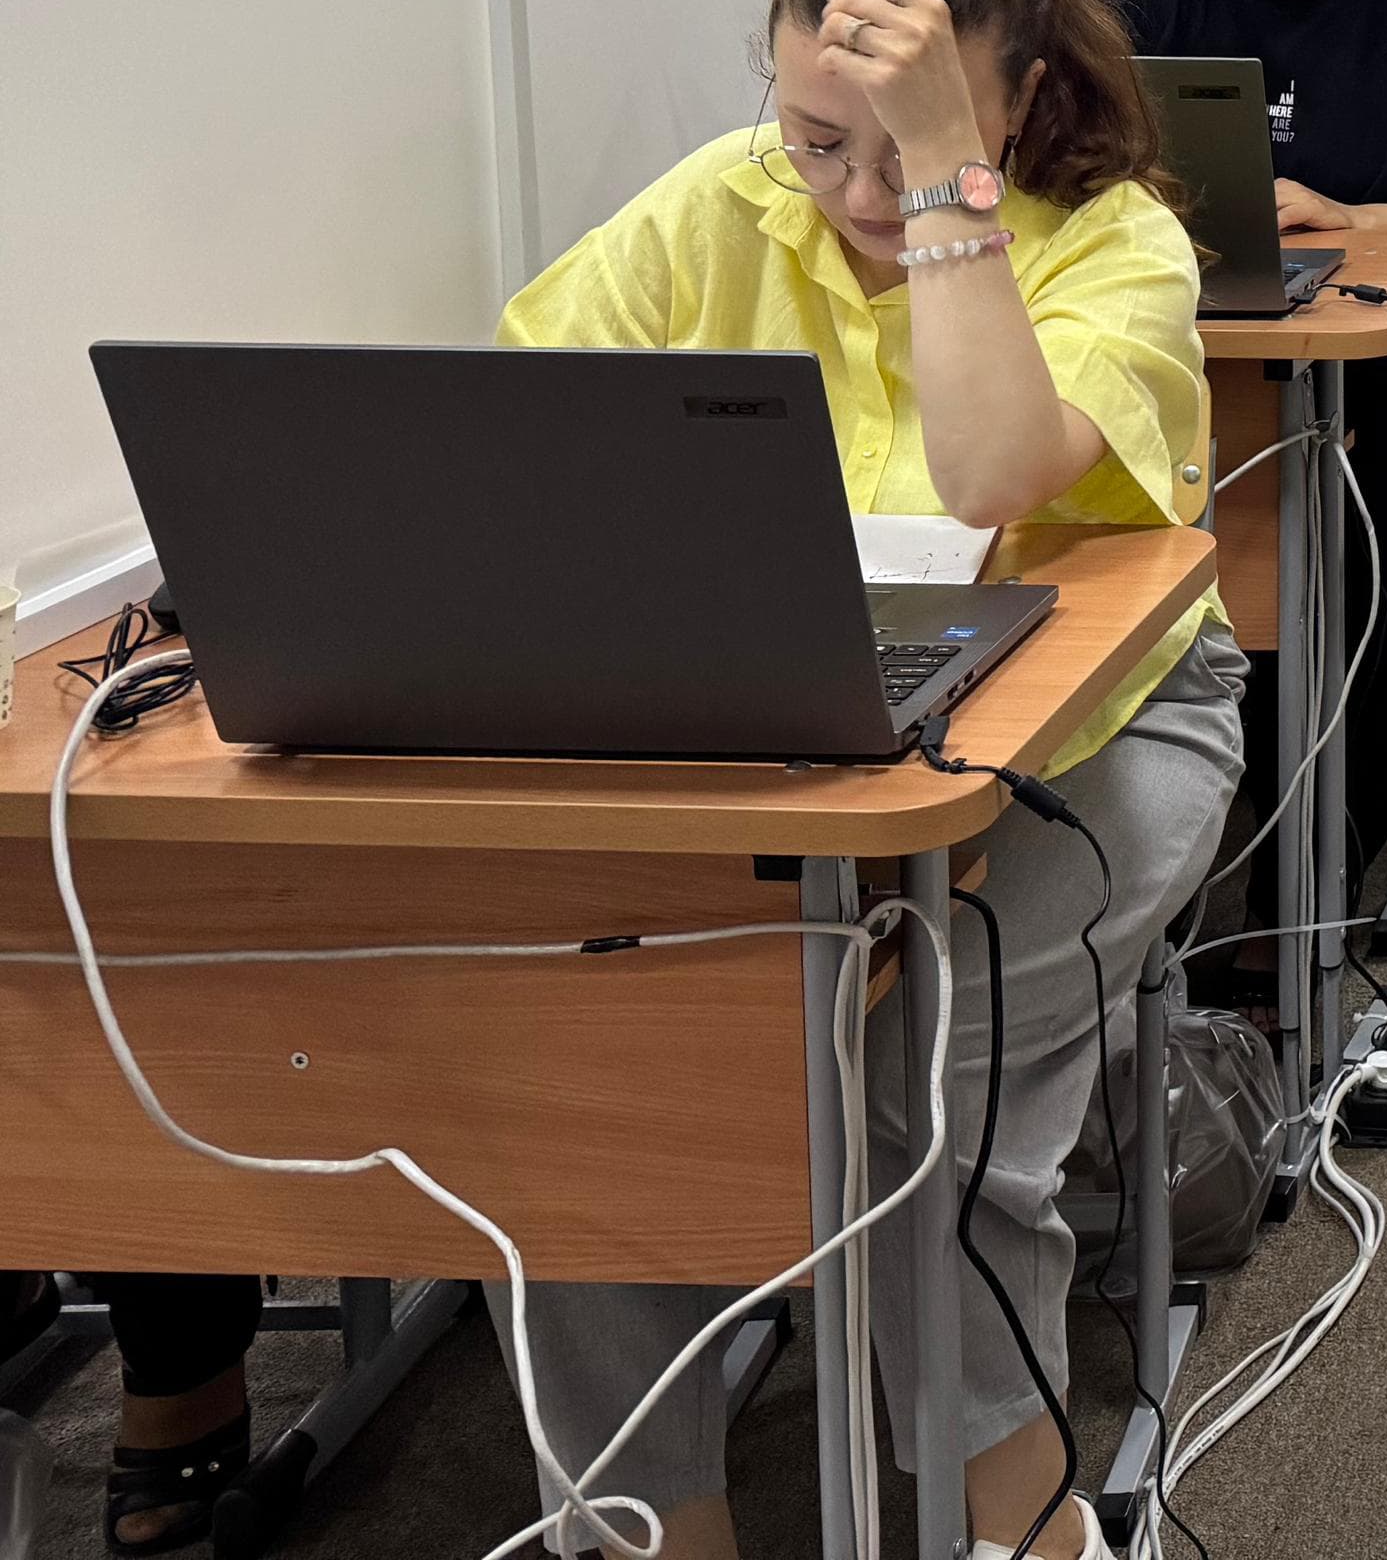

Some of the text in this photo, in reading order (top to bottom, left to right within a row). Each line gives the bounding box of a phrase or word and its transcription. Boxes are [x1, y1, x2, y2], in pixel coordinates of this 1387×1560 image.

[1290, 79, 1295, 92] I
[1279, 92, 1294, 105] AM
[1271, 117, 1292, 130] ARE
[1271, 130, 1295, 142] YOU?
[706, 401, 768, 416] acer
